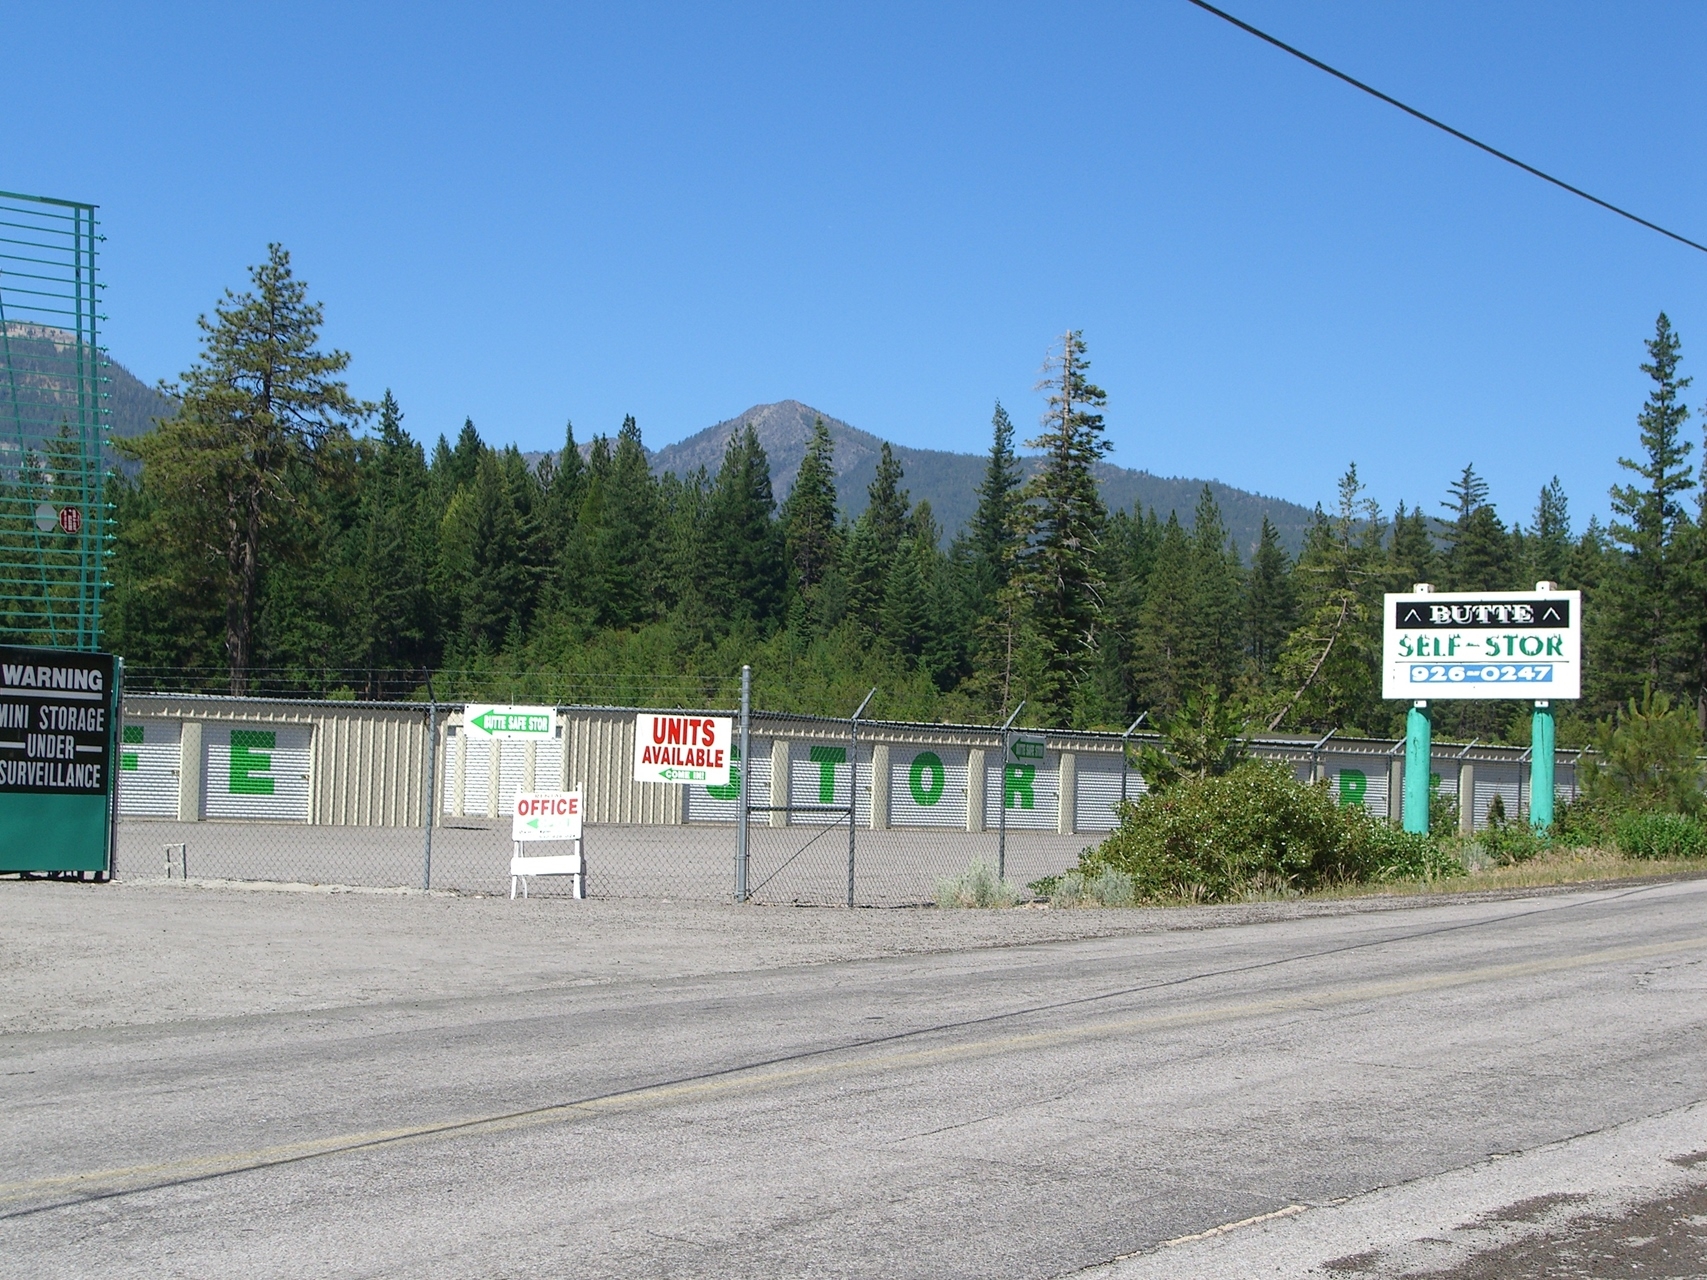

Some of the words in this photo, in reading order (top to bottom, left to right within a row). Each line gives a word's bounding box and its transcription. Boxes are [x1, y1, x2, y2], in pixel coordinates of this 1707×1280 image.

[1429, 604, 1535, 625] BUTTE
[1398, 633, 1564, 658] SELF-STOR
[2, 664, 103, 691] WARNING
[1411, 666, 1552, 682] 926-0247
[0, 704, 29, 729] MINI
[39, 705, 104, 732] STORAGE
[484, 715, 507, 730] BUTTE
[508, 715, 527, 731] SAFE
[528, 716, 548, 732] STOR
[653, 717, 715, 747] UNITS
[27, 733, 75, 760] UNDER
[642, 746, 724, 768] AVAILABLE
[0, 761, 100, 788] SURVEILLANCE
[517, 798, 579, 817] OFFICE
